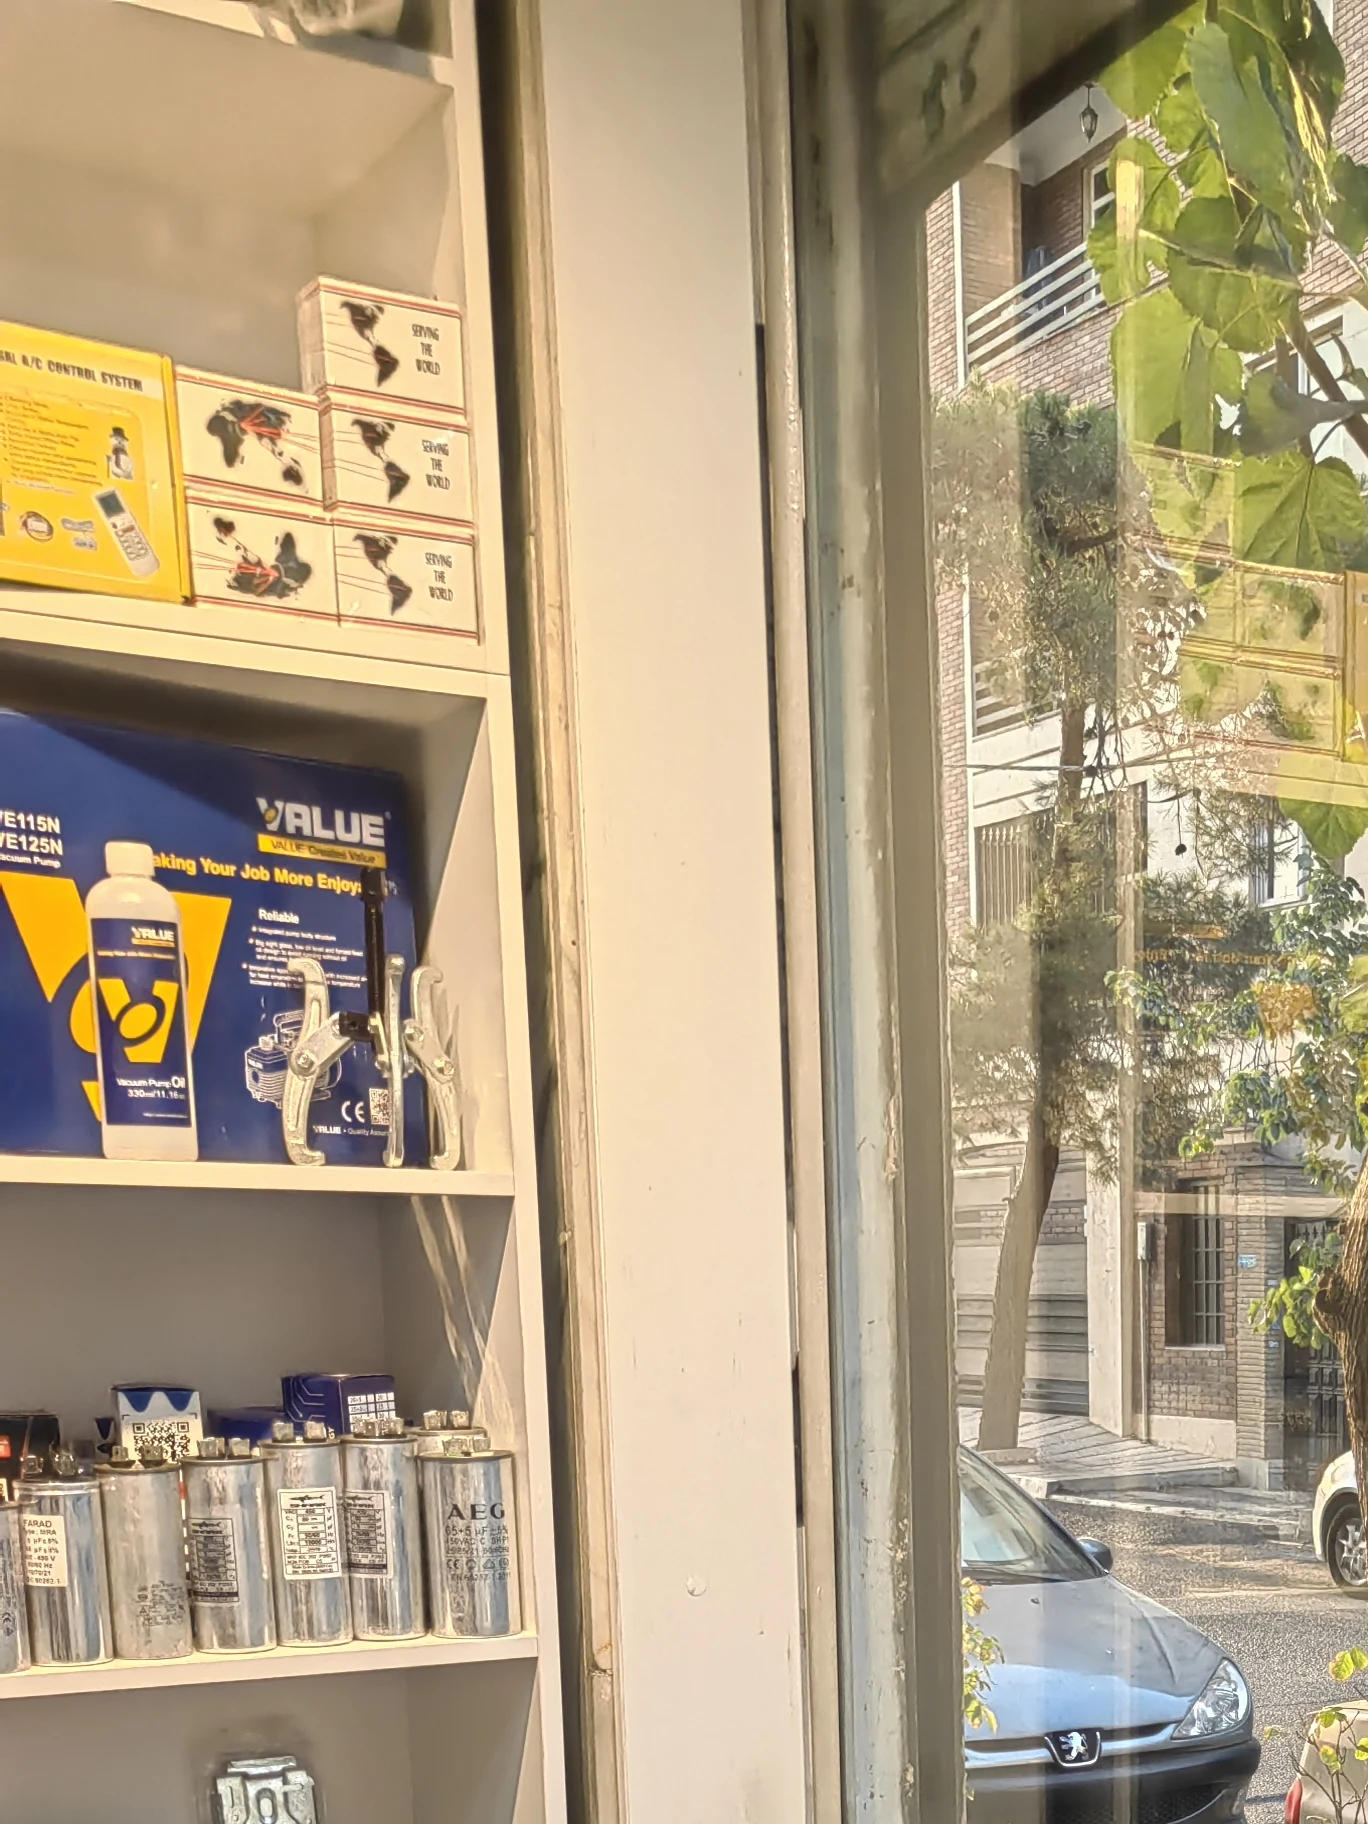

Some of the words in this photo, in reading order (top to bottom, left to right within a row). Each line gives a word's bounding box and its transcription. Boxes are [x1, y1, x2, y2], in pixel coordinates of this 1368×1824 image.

[411, 323, 440, 341] SERVING
[420, 342, 433, 357] THE
[415, 358, 441, 375] WORLD
[47, 359, 97, 382] CONTROL
[101, 371, 143, 392] SYSTEM
[430, 457, 443, 472] THE
[426, 474, 450, 490] WORLD
[425, 552, 452, 568] SERVING
[433, 569, 446, 584] THE
[428, 586, 453, 602] WORLD
[256, 797, 385, 847] VALUE
[200, 858, 236, 877] Your
[241, 864, 270, 882] Job
[275, 868, 314, 888] More
[258, 907, 300, 924] Reliable
[171, 1076, 186, 1089] Oil
[447, 1502, 505, 1520] AEG
